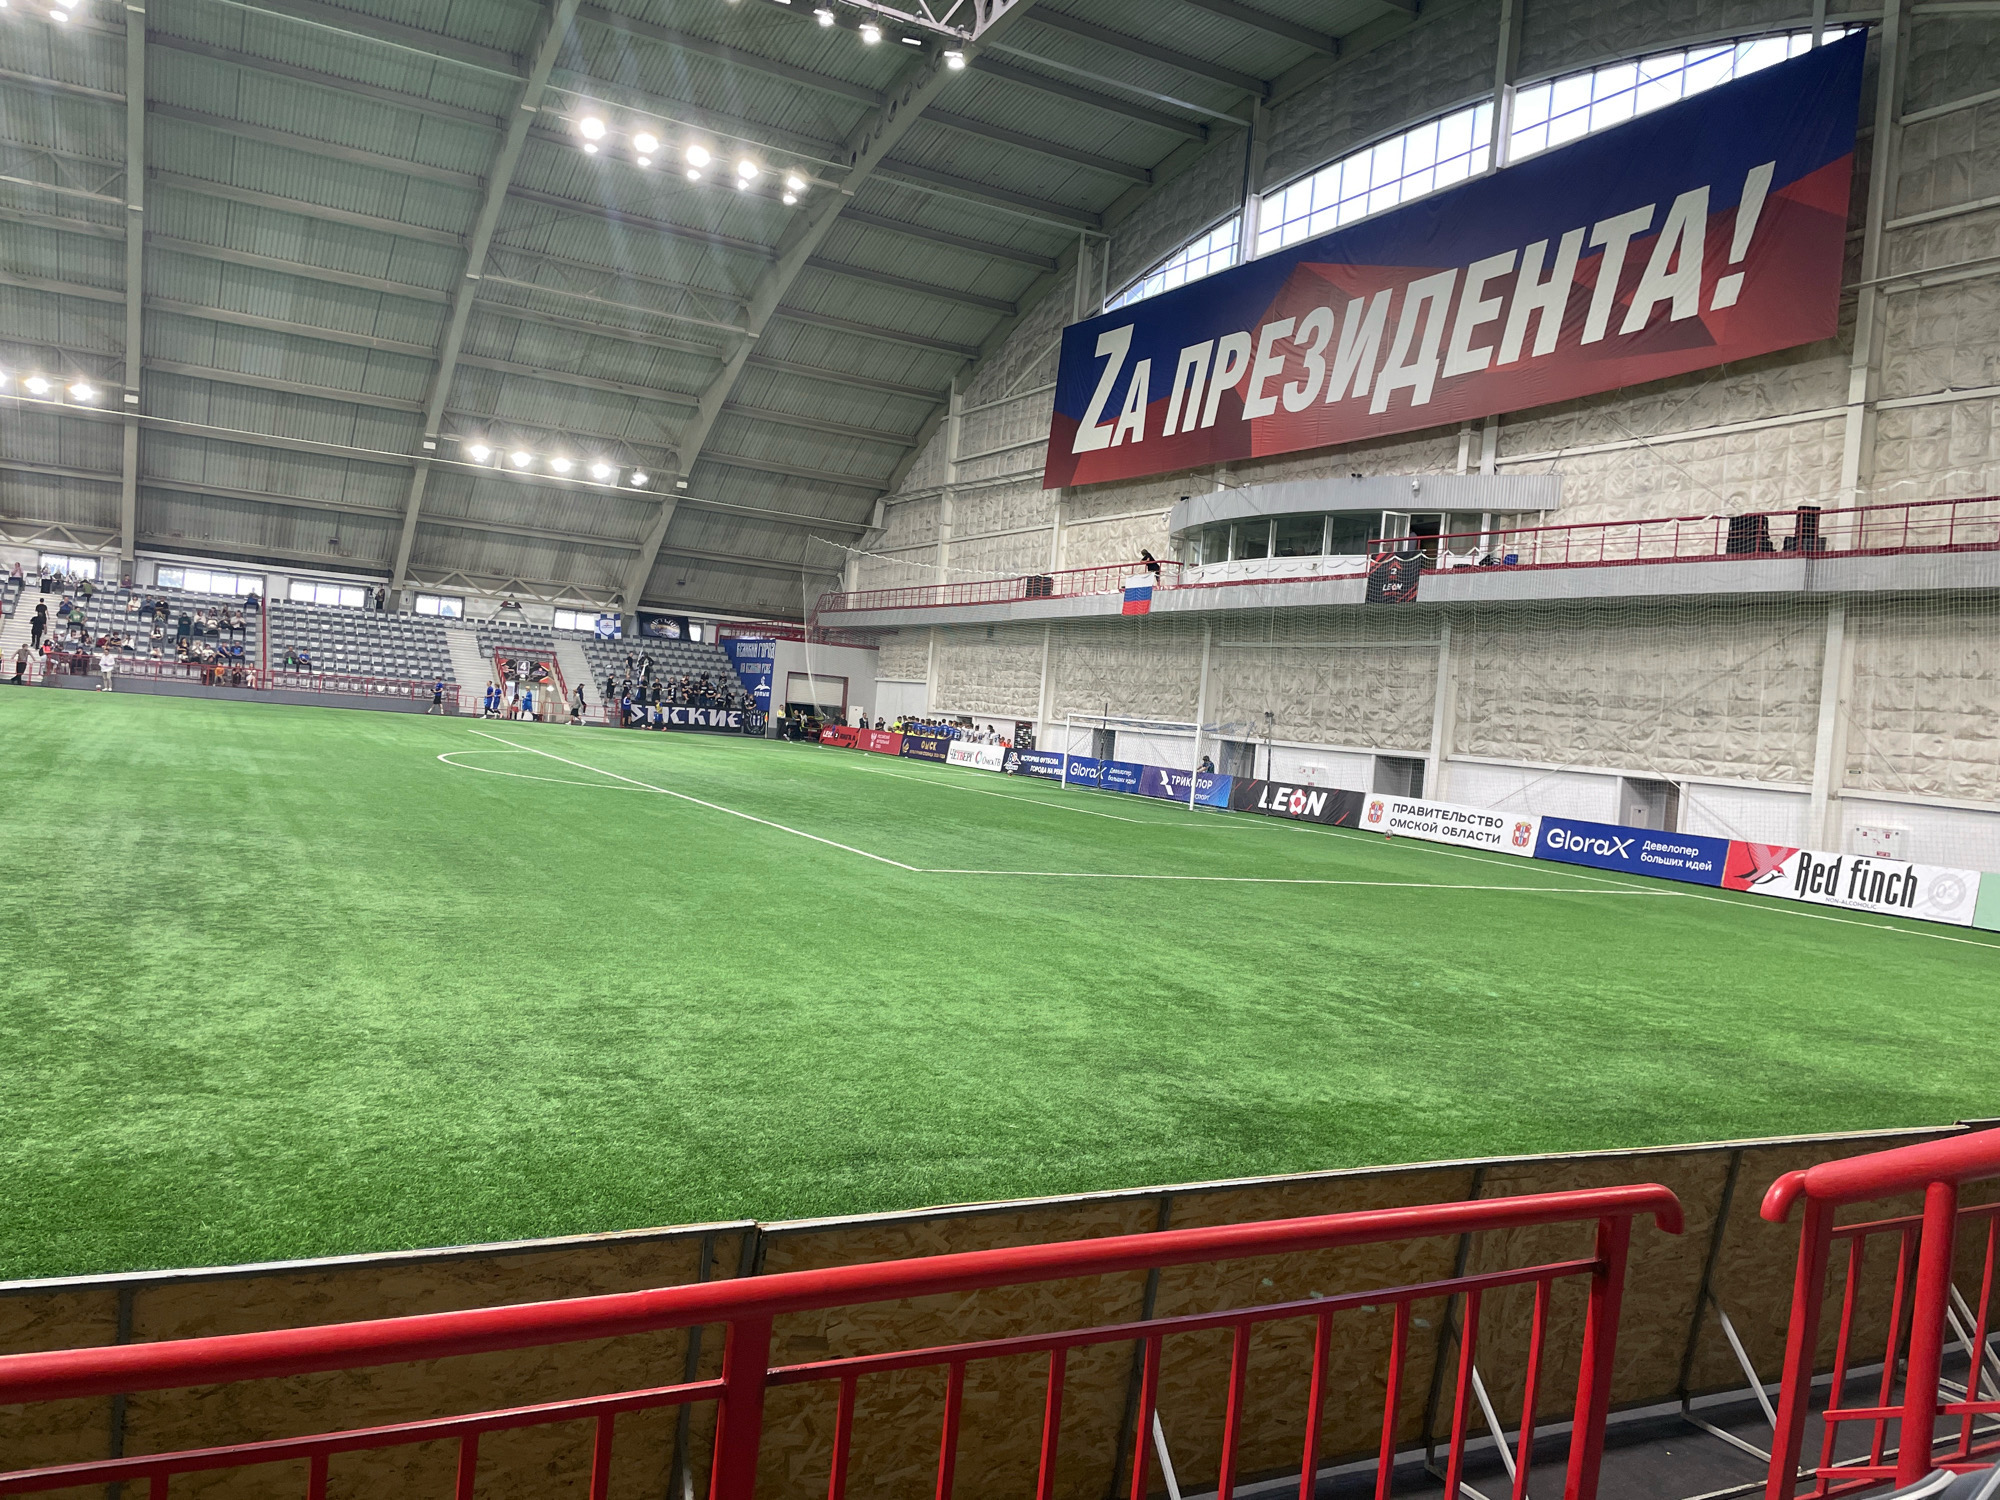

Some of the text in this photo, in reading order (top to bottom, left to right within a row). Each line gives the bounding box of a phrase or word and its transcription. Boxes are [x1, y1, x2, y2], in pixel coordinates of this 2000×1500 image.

[1163, 161, 1776, 437] ПРЕЗИДЕНТА!
[520, 662, 527, 671] 4
[1070, 762, 1108, 780] GloraX
[1171, 775, 1213, 790] ТРИКЛОР
[1257, 785, 1328, 817] LEON
[1392, 803, 1504, 830] ПРАВИТЕЛЬСТВО
[1389, 818, 1502, 845] ОМСКОЙ ОБЛАСТИ
[1547, 828, 1636, 860] GloraX
[1642, 840, 1700, 858] Девелопер
[1640, 852, 1713, 872] больших идей
[1794, 851, 1919, 909] Red finch
[1825, 897, 1878, 910] NON-ALCOHOLIC
